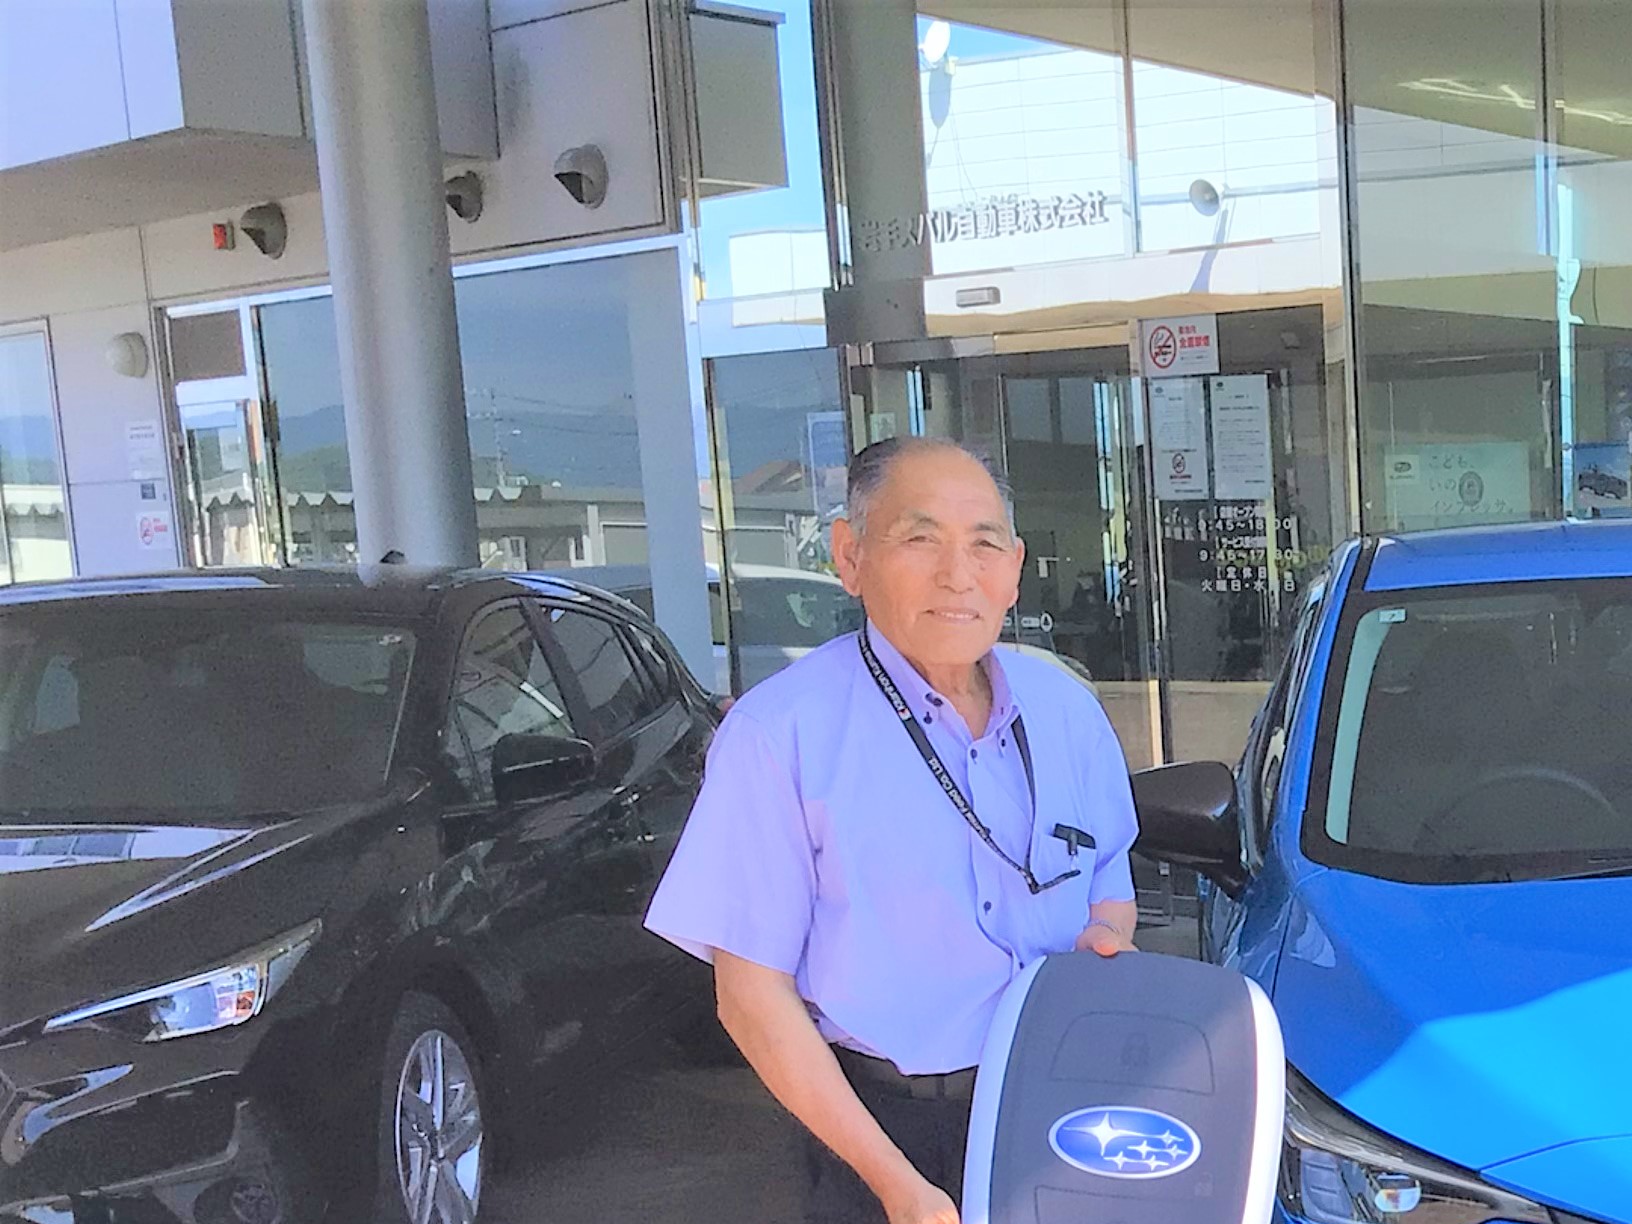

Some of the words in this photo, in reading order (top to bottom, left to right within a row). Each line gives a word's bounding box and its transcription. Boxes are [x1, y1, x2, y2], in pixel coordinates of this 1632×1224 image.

[1201, 579, 1296, 593] 火曜日・水日
